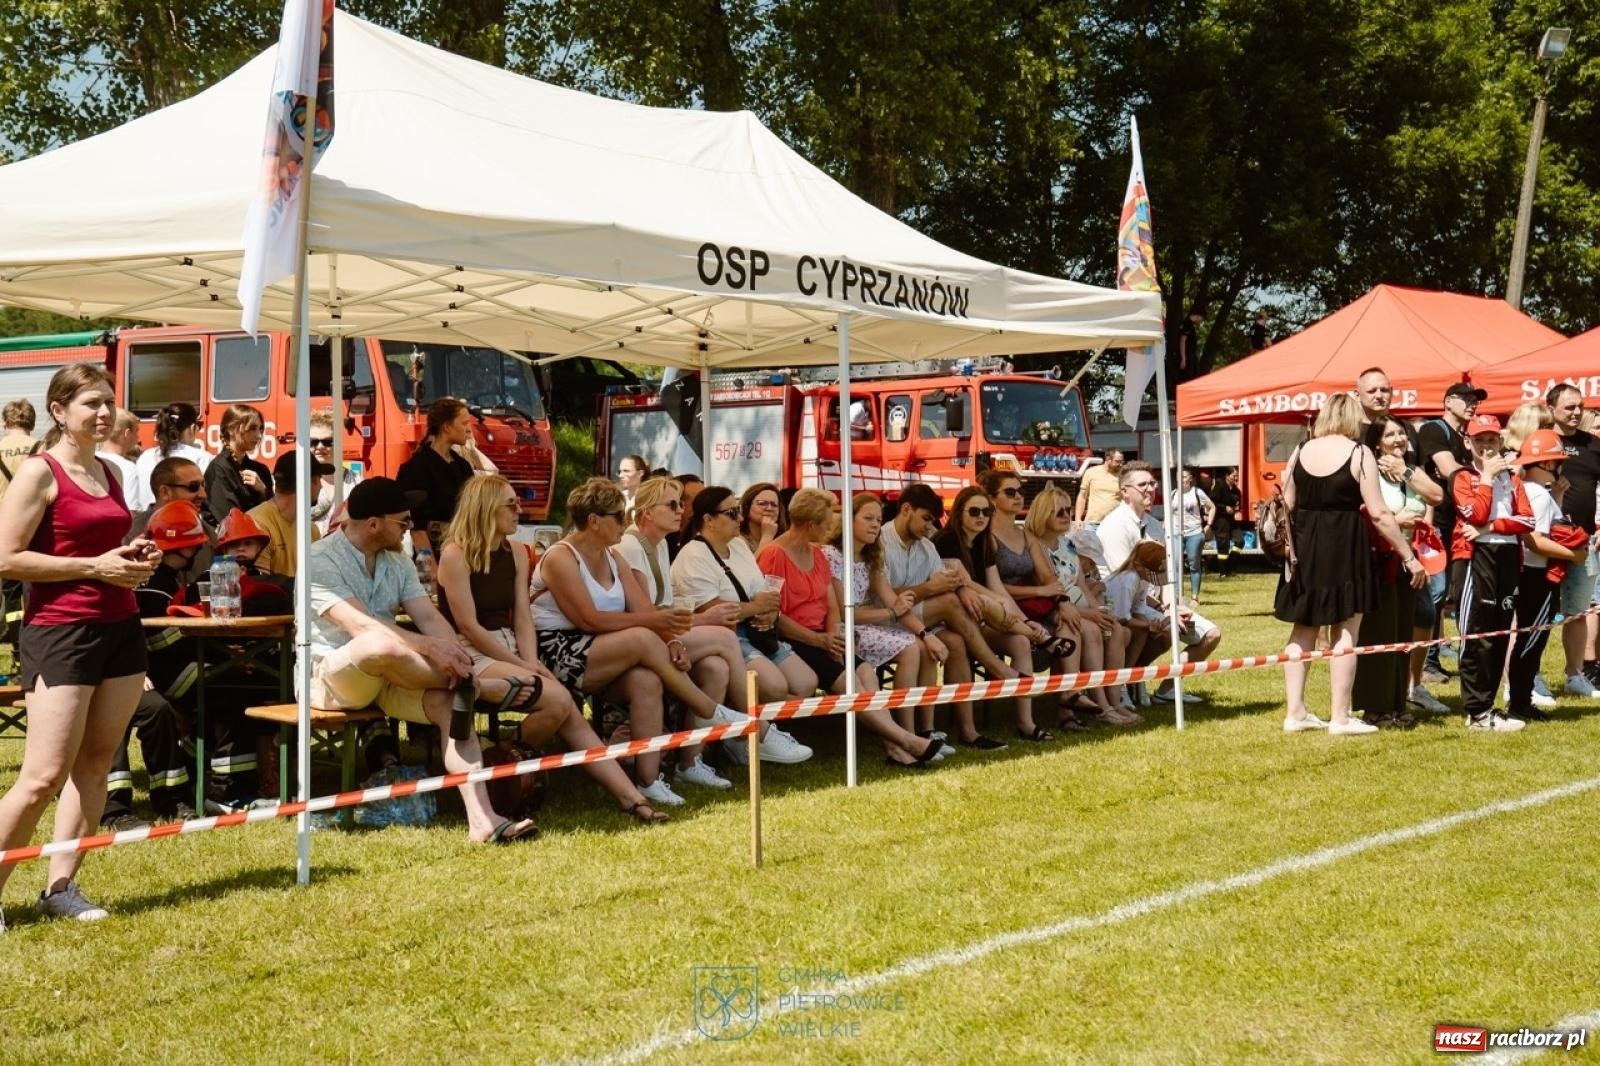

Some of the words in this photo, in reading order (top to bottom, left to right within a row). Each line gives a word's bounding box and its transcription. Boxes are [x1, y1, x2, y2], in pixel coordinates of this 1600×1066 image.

[697, 242, 770, 291] OSP
[797, 255, 970, 318] CYPRZANÓW
[1218, 389, 1417, 415] SAMBORCE
